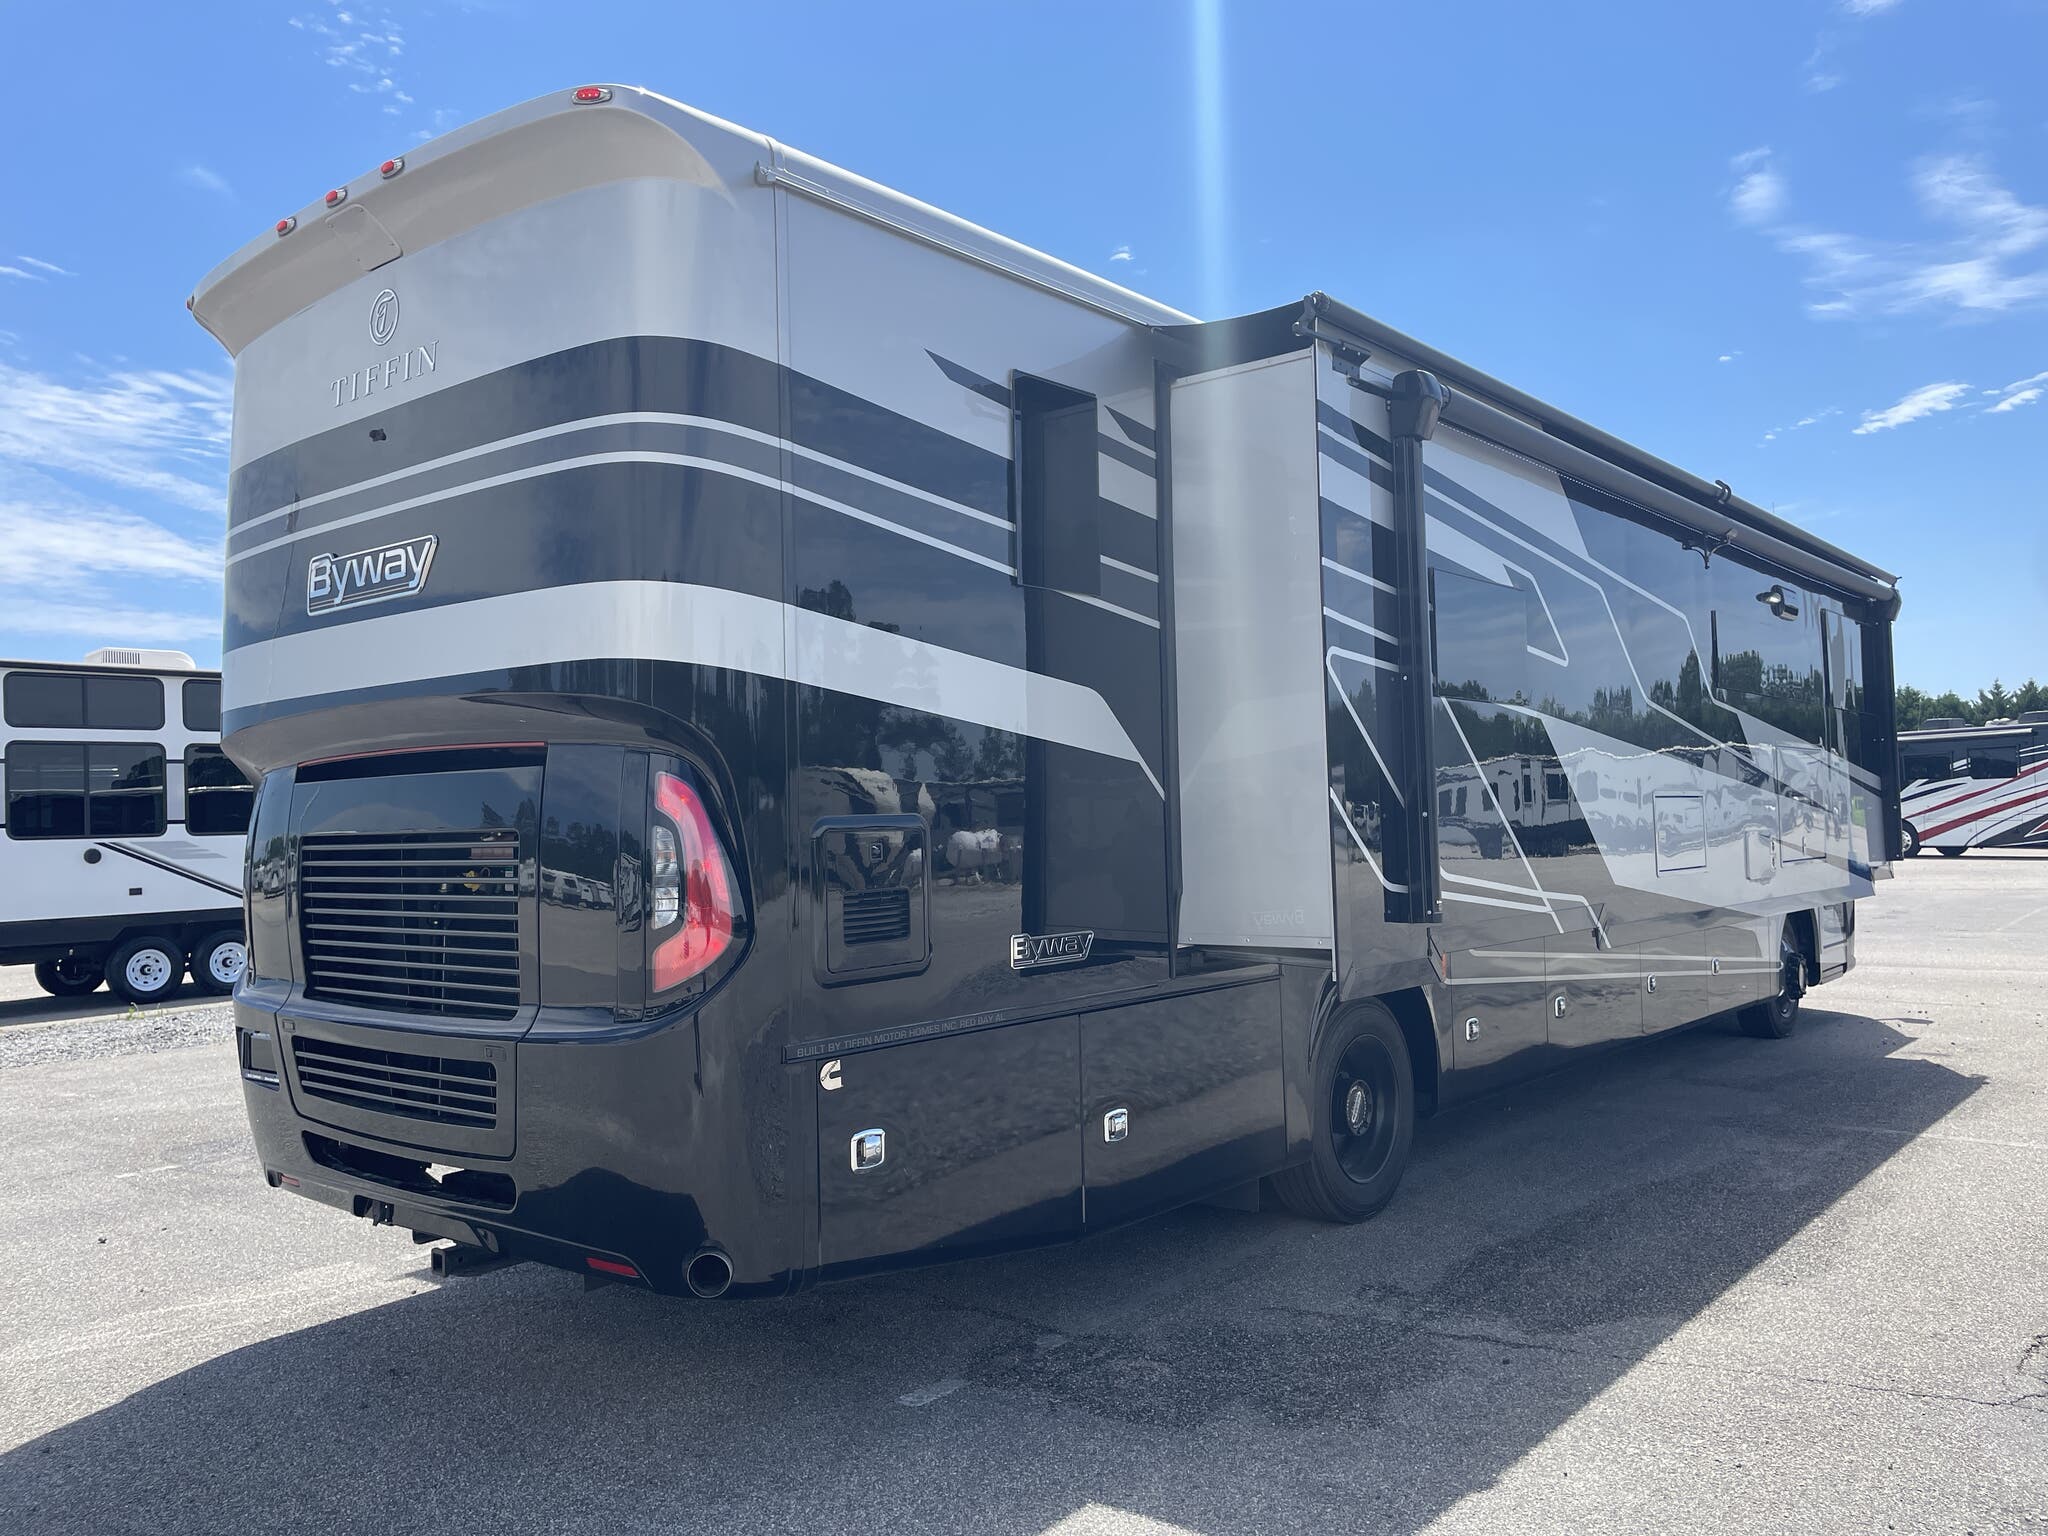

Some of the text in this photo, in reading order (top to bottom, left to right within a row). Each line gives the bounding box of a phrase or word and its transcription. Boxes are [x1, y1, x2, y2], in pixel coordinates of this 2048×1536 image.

[330, 339, 440, 408] TIFFIN
[309, 541, 431, 605] Byway
[1013, 933, 1092, 964] Byway
[796, 1043, 825, 1057] BUILT
[828, 1042, 842, 1052] BY
[844, 1036, 872, 1049] TIFFIN
[874, 1030, 907, 1044] MOTOR
[909, 1024, 940, 1038] HOMES
